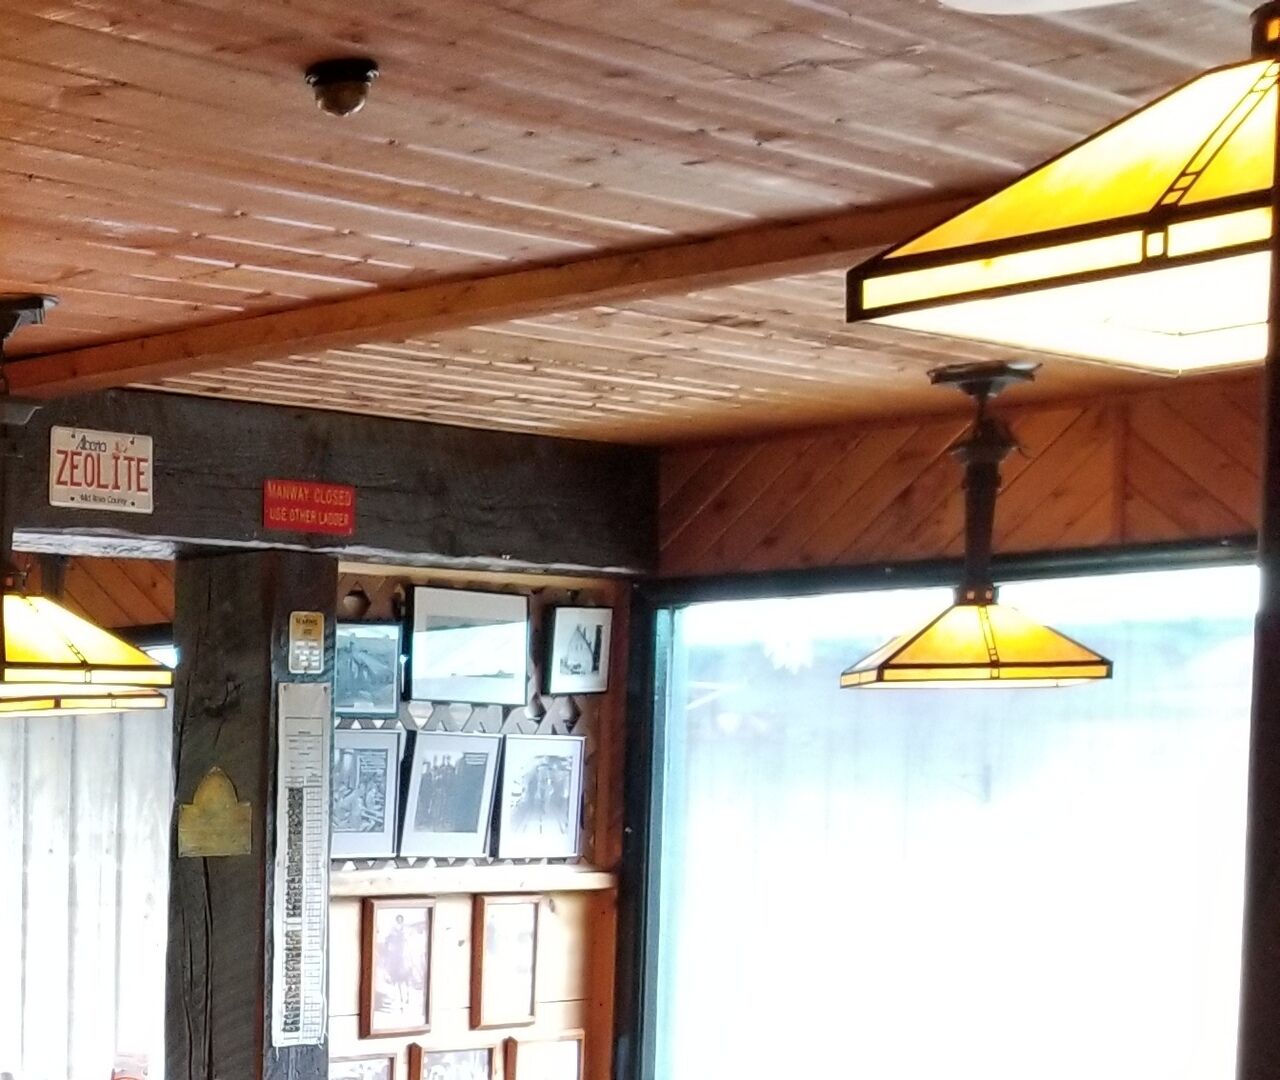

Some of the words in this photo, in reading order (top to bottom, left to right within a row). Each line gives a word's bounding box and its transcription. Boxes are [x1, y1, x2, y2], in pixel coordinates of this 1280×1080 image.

[55, 449, 149, 492] ZEOLITE
[267, 480, 310, 501] MANWAY
[314, 487, 352, 507] CLOSED
[269, 507, 288, 521] USE
[289, 508, 317, 523] OTHER
